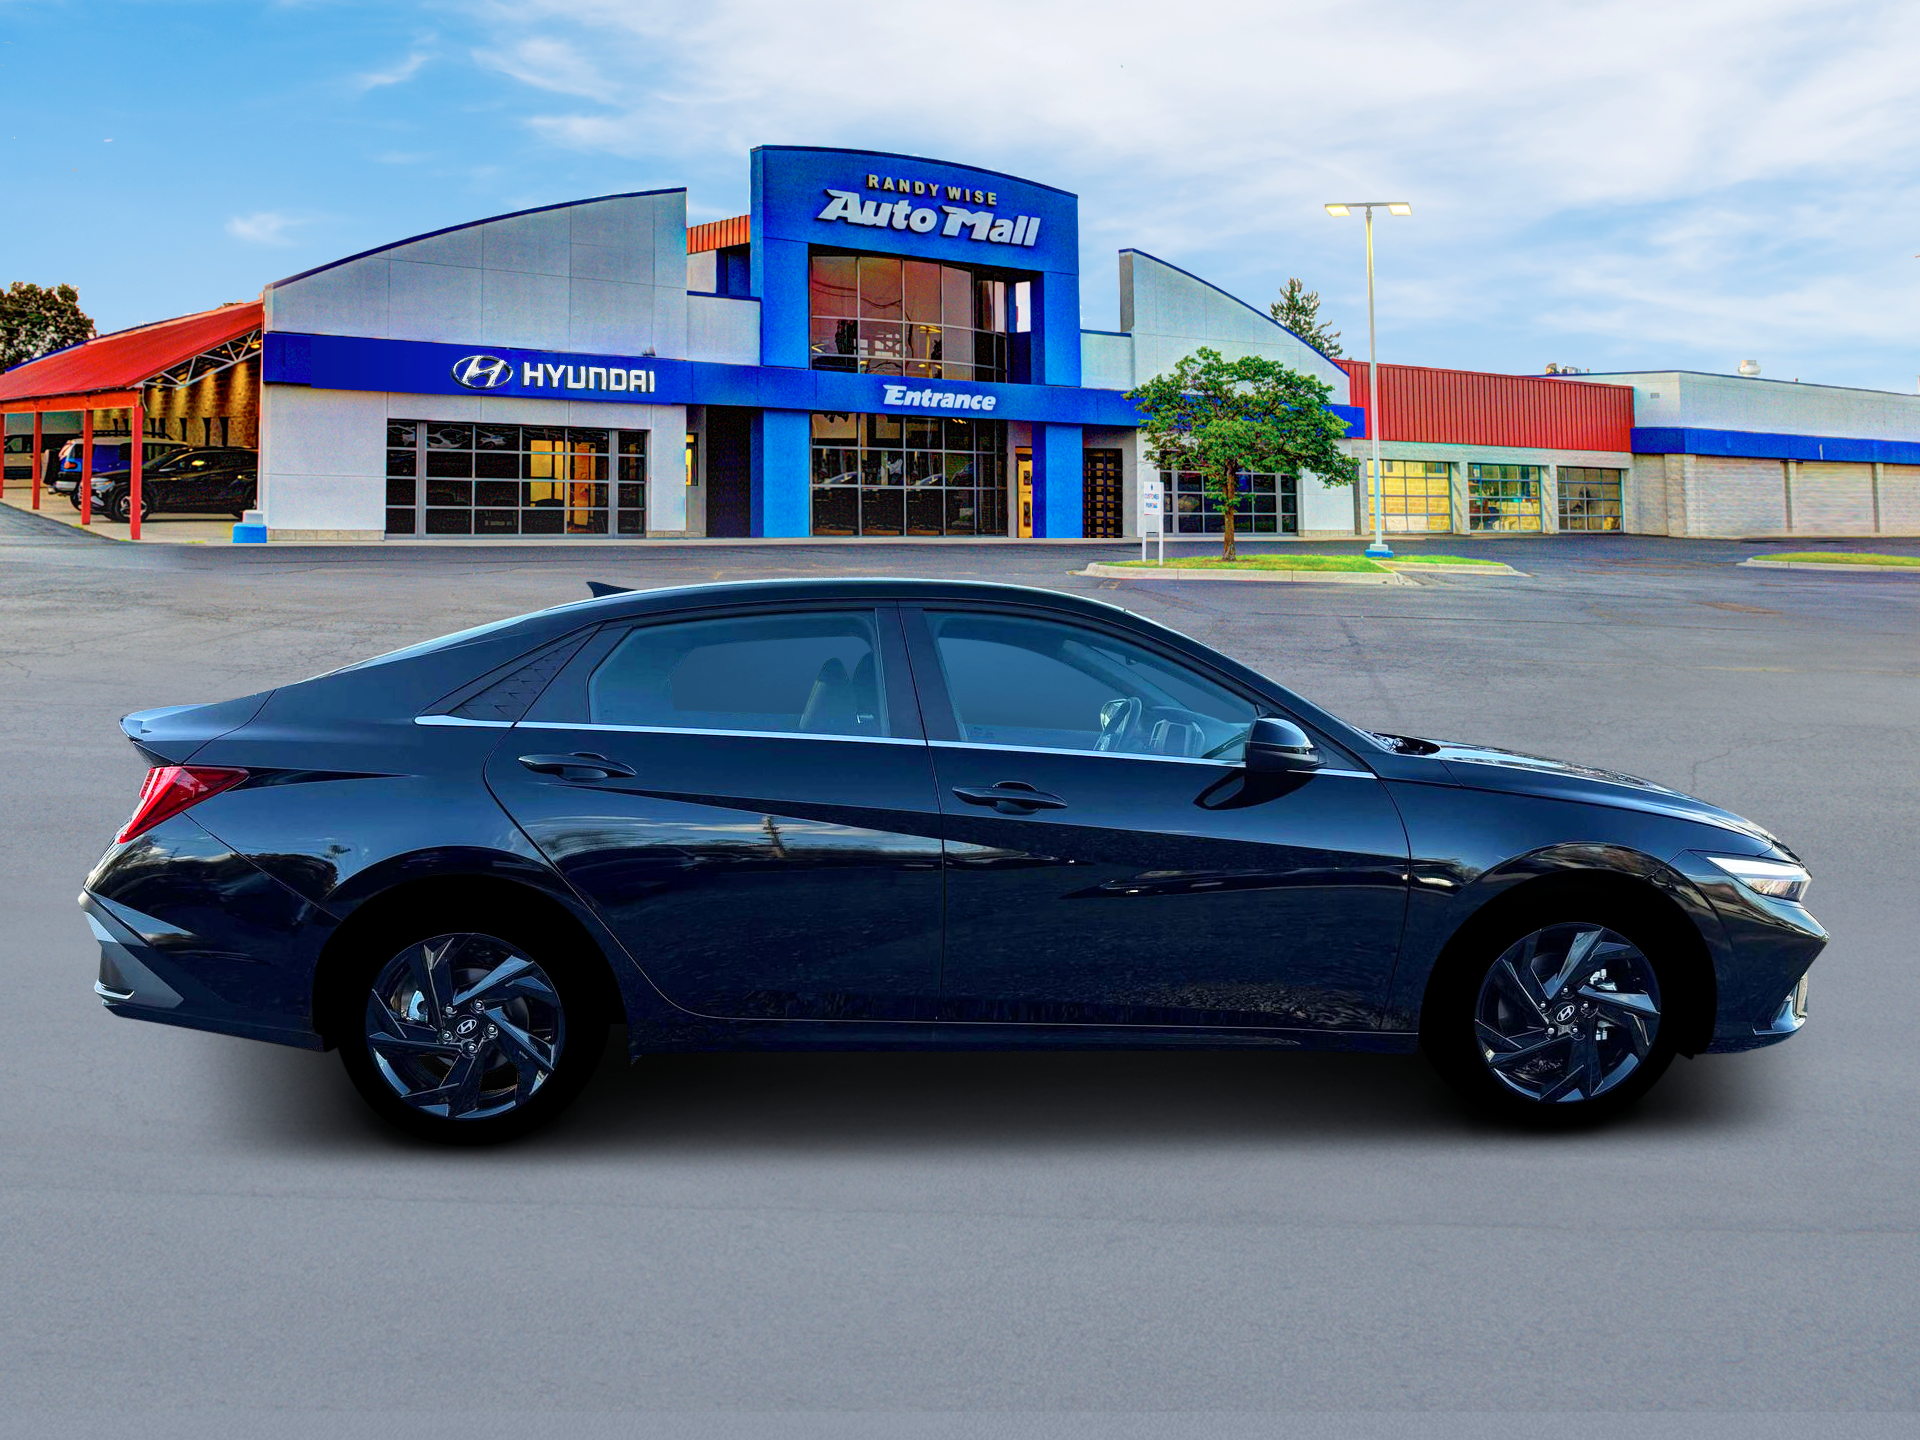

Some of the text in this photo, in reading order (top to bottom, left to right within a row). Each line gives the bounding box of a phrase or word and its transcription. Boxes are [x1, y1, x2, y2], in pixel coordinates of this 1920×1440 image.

[866, 174, 997, 206] RANDY WISE
[816, 188, 1041, 247] Auto Mall
[521, 362, 655, 393] HYUNDAI
[883, 384, 997, 411] Entrance
